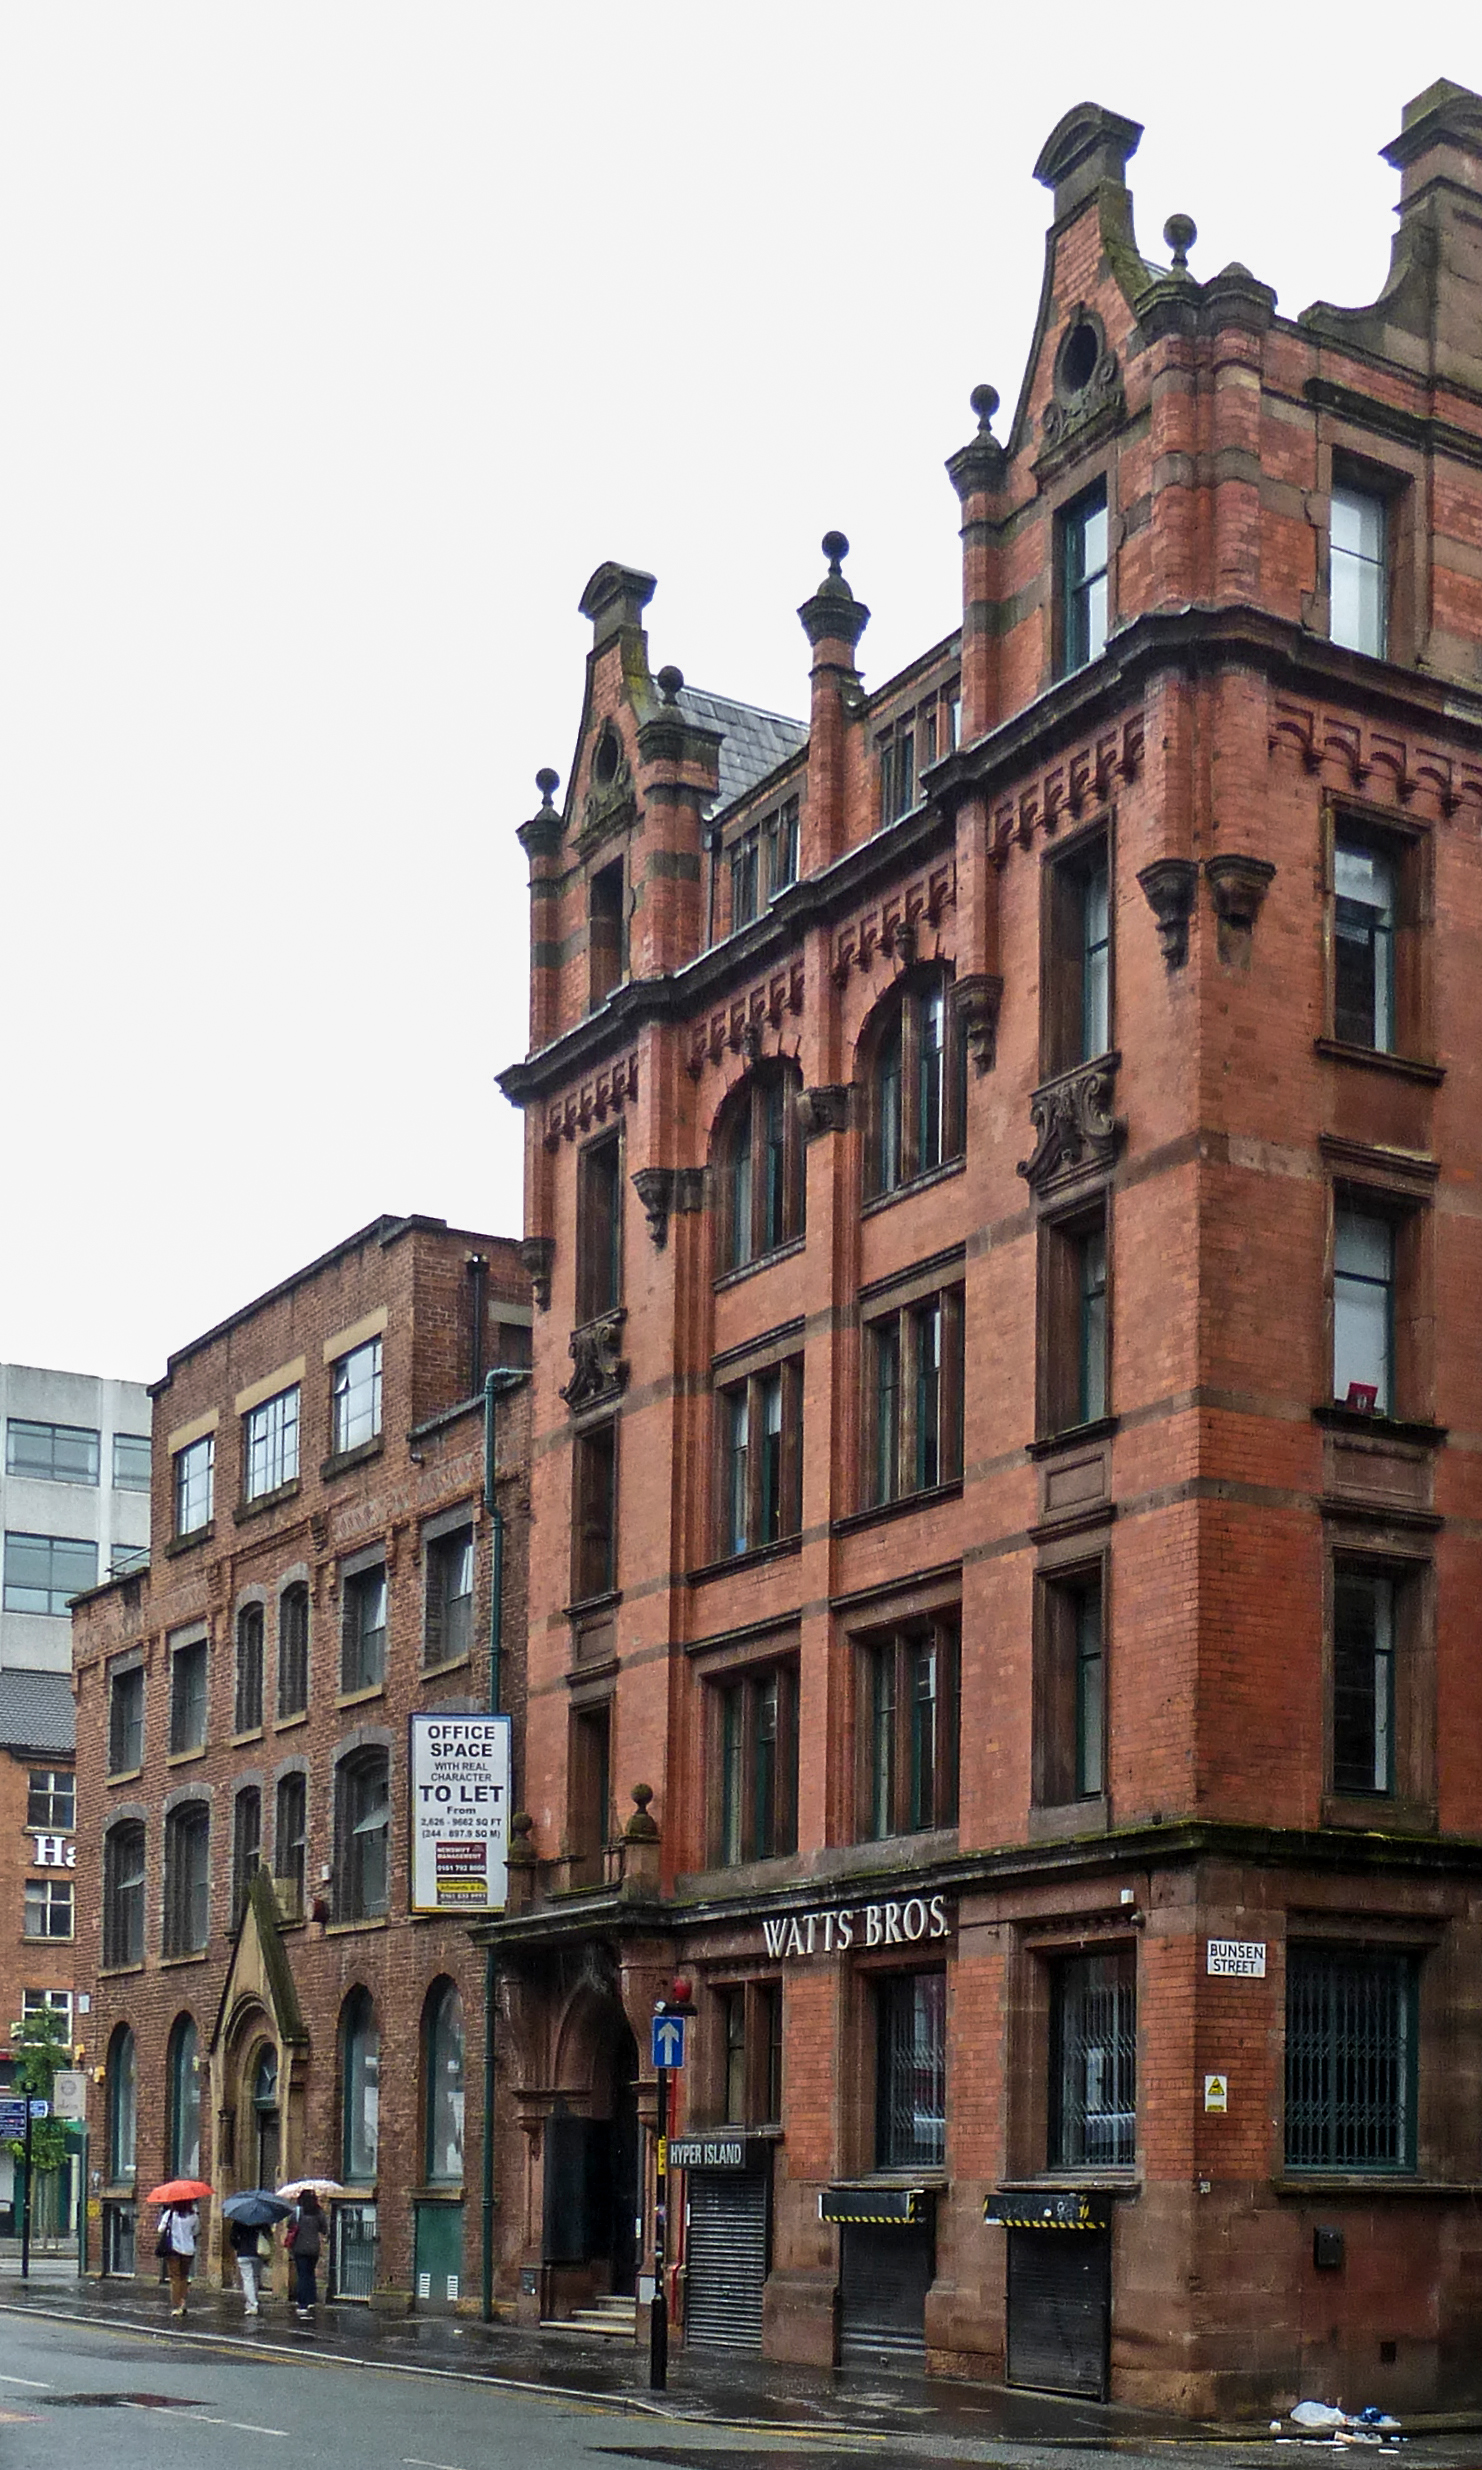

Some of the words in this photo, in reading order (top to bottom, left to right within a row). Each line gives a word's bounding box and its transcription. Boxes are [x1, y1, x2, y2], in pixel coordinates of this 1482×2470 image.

[428, 1725, 495, 1740] OFFICE
[430, 1743, 493, 1757] SPACE
[434, 1762, 460, 1771] WITH
[462, 1762, 488, 1771] REAL
[431, 1773, 492, 1782] CHARACTER
[419, 1785, 452, 1802] TO
[460, 1785, 504, 1802] LET
[447, 1806, 476, 1815] From
[475, 1818, 488, 1826] SQ
[490, 1818, 502, 1826] FT
[475, 1829, 487, 1838] SQ
[763, 1910, 854, 1958] WATTS
[865, 1895, 951, 1946] BROS.
[1210, 1943, 1263, 1959] BUNSEN
[1213, 1958, 1256, 1973] STREET
[670, 2143, 702, 2165] HYPER
[704, 2143, 742, 2165] ISLAND
